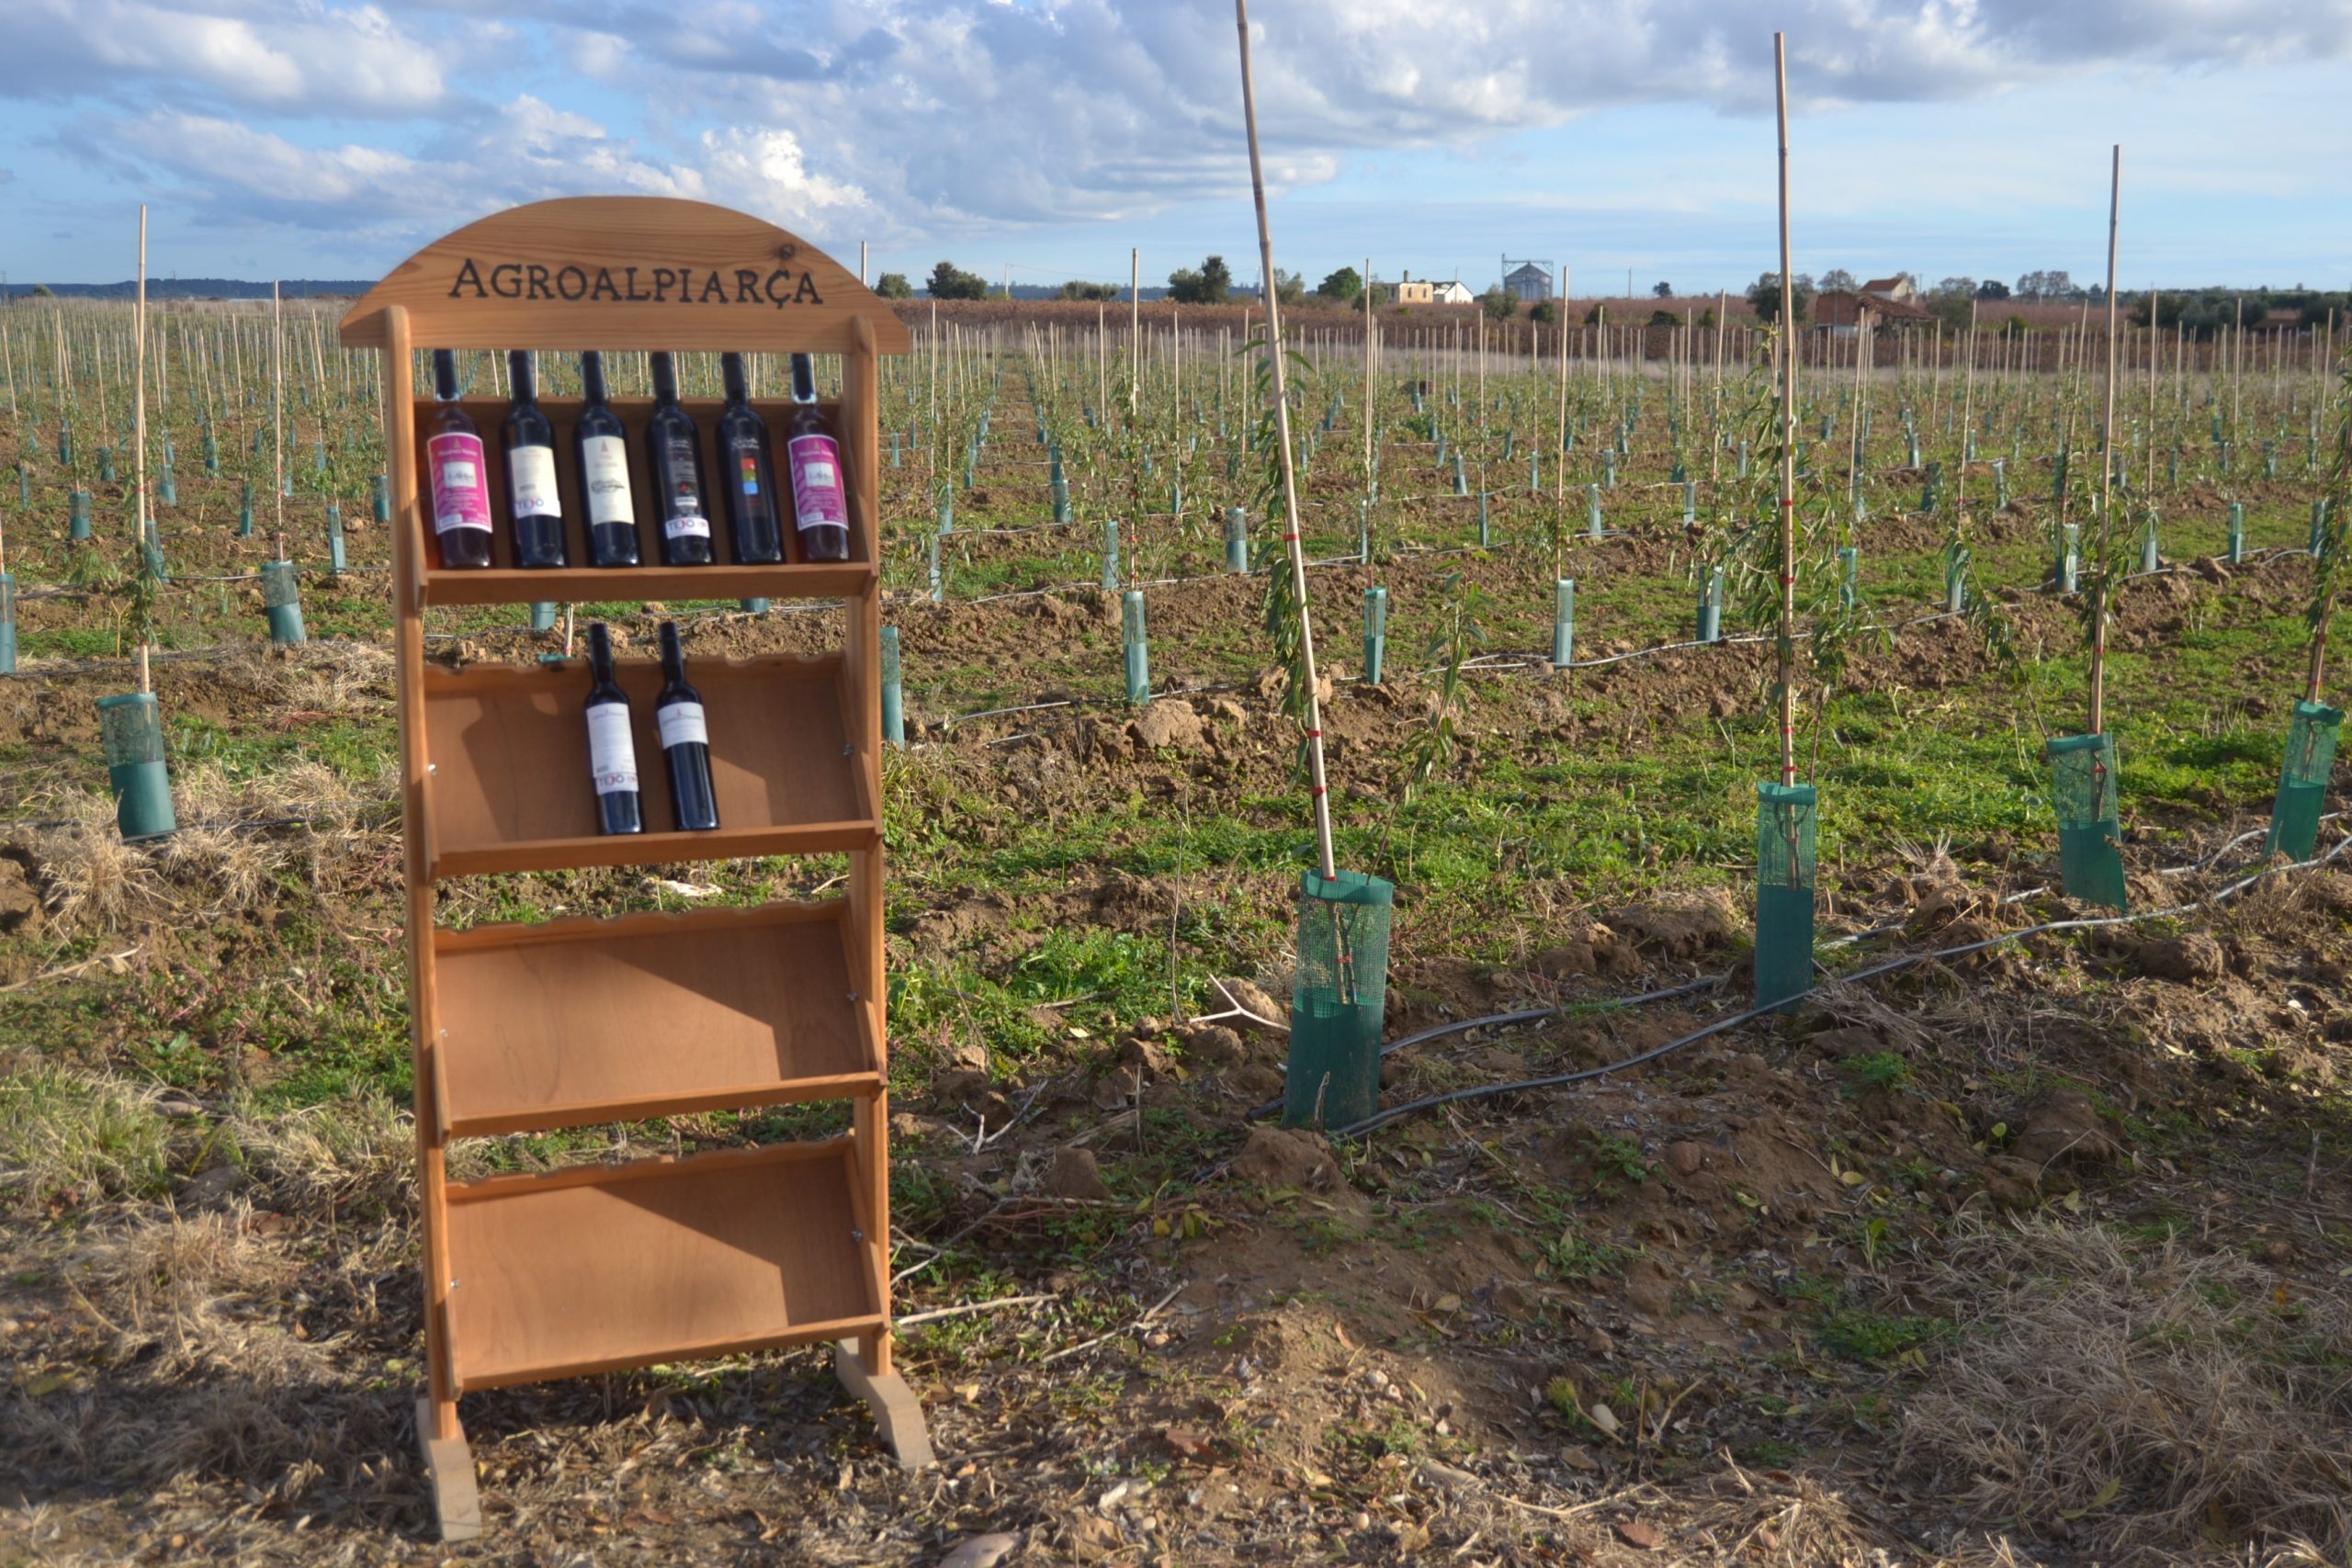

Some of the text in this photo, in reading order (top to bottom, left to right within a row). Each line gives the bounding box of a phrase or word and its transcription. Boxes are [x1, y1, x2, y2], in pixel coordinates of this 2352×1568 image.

[448, 258, 823, 309] AGROALPIARÇA
[516, 498, 544, 511] TEJO
[668, 518, 695, 531] TEJO
[598, 773, 625, 787] TEJO
